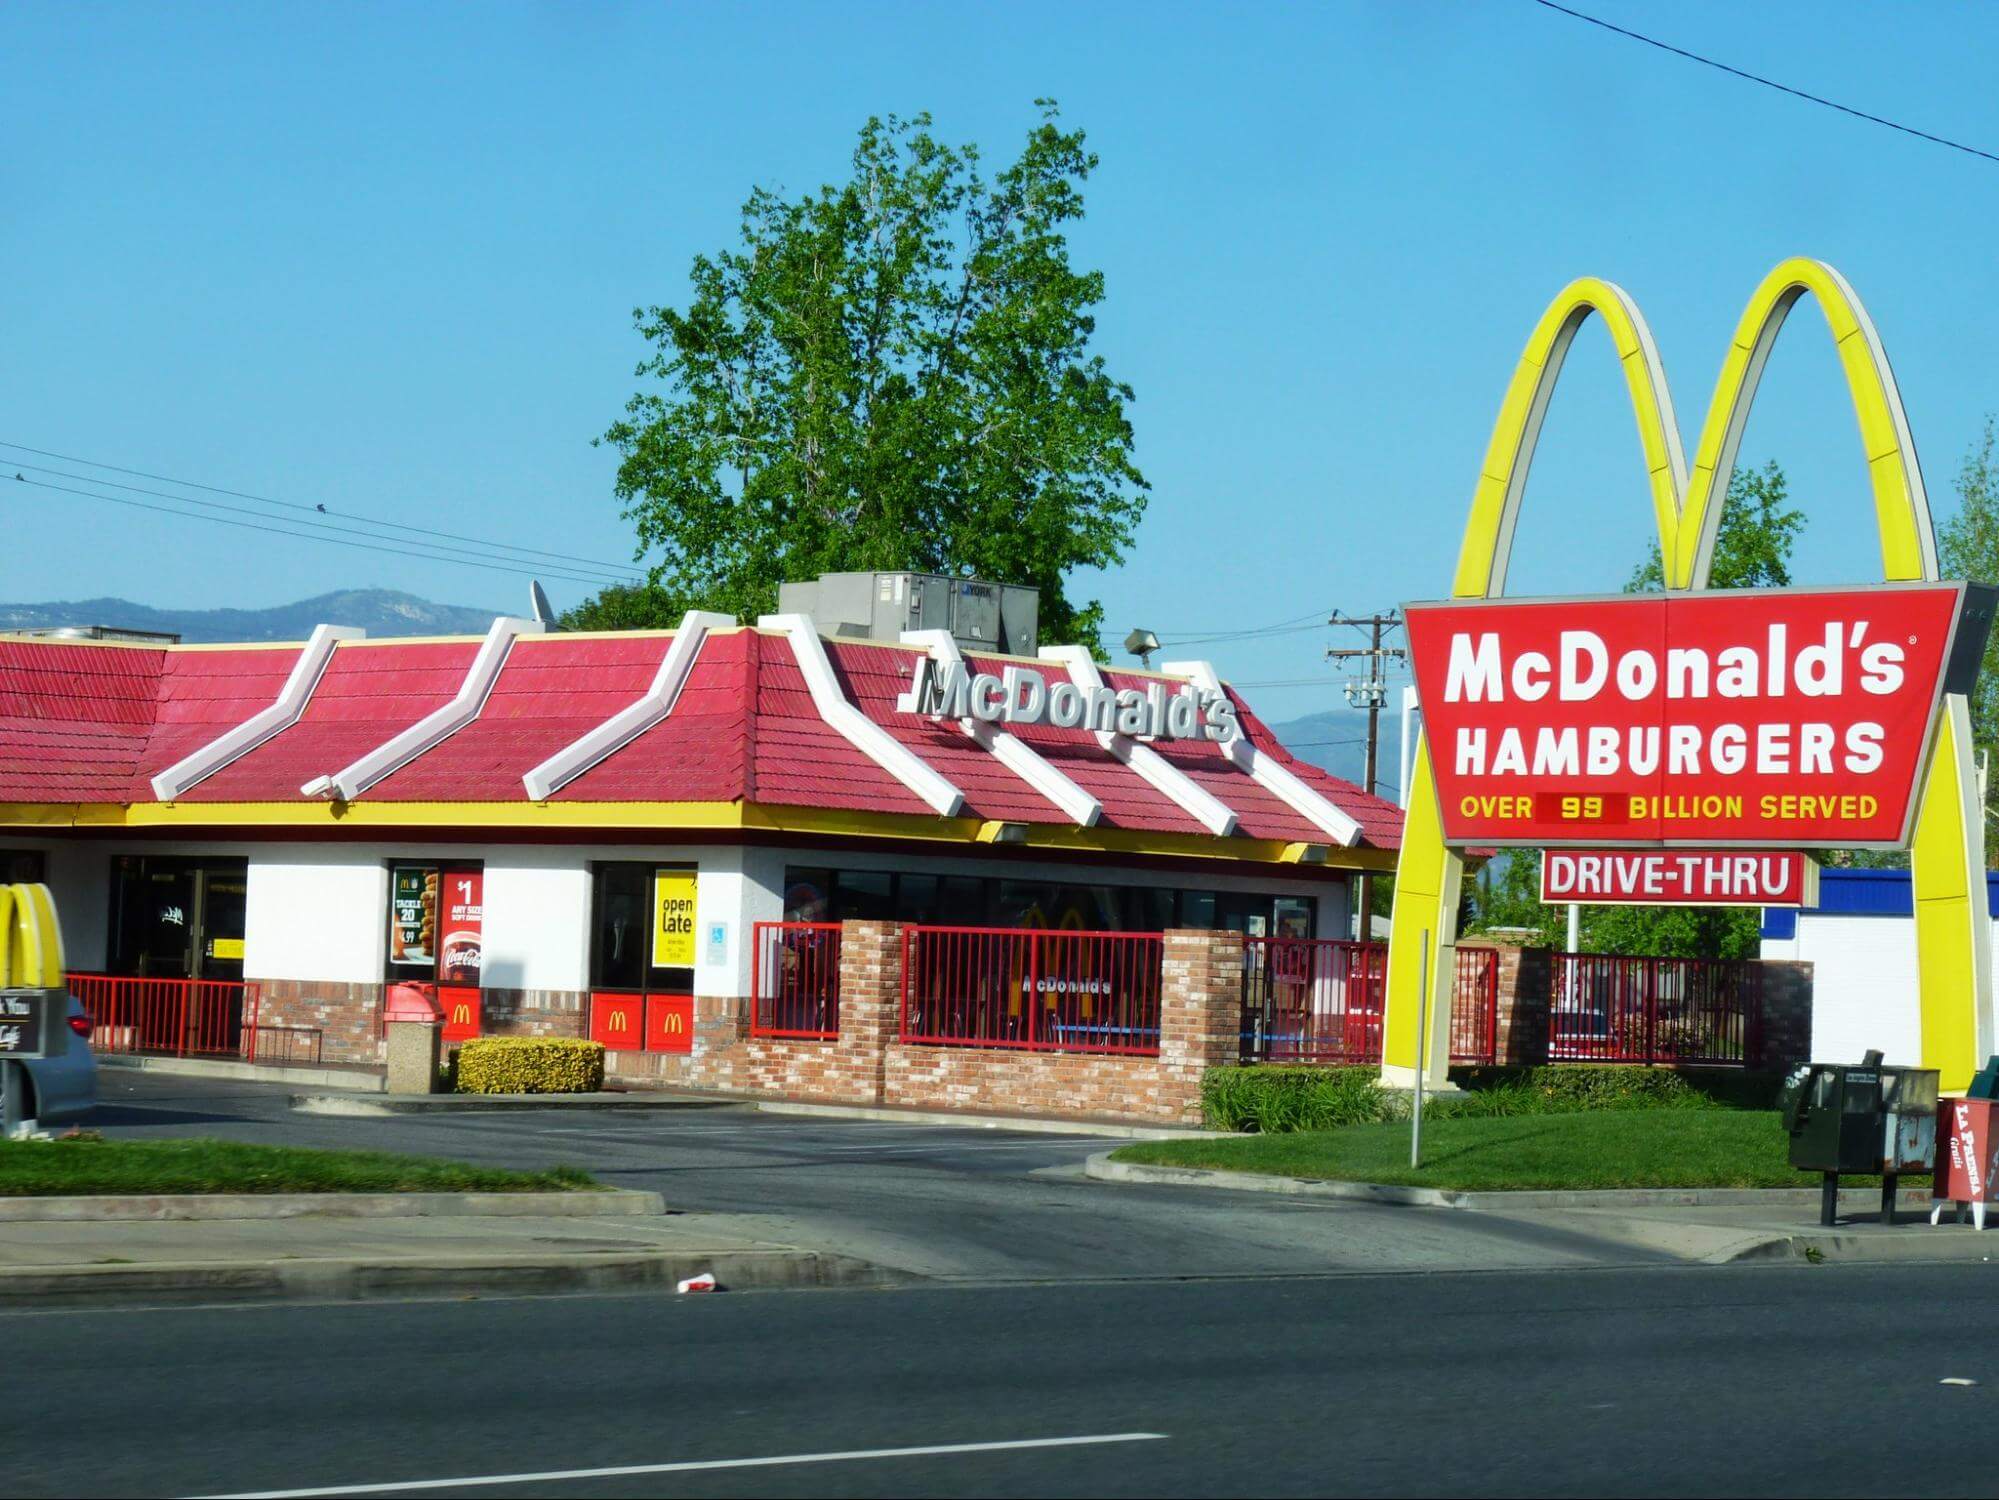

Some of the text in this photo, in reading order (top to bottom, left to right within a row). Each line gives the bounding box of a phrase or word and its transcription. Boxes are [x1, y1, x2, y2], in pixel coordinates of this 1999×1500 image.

[1444, 621, 1905, 702] McDonald's
[897, 656, 1236, 742] McDonald's
[1455, 721, 1885, 776] HAMBURGERS
[1460, 795, 1878, 819] OVER 99 BILLION SERVED
[1550, 856, 1790, 895] DRIVE-THRU
[400, 909, 415, 921] 20
[663, 899, 693, 915] open
[663, 912, 692, 933] late
